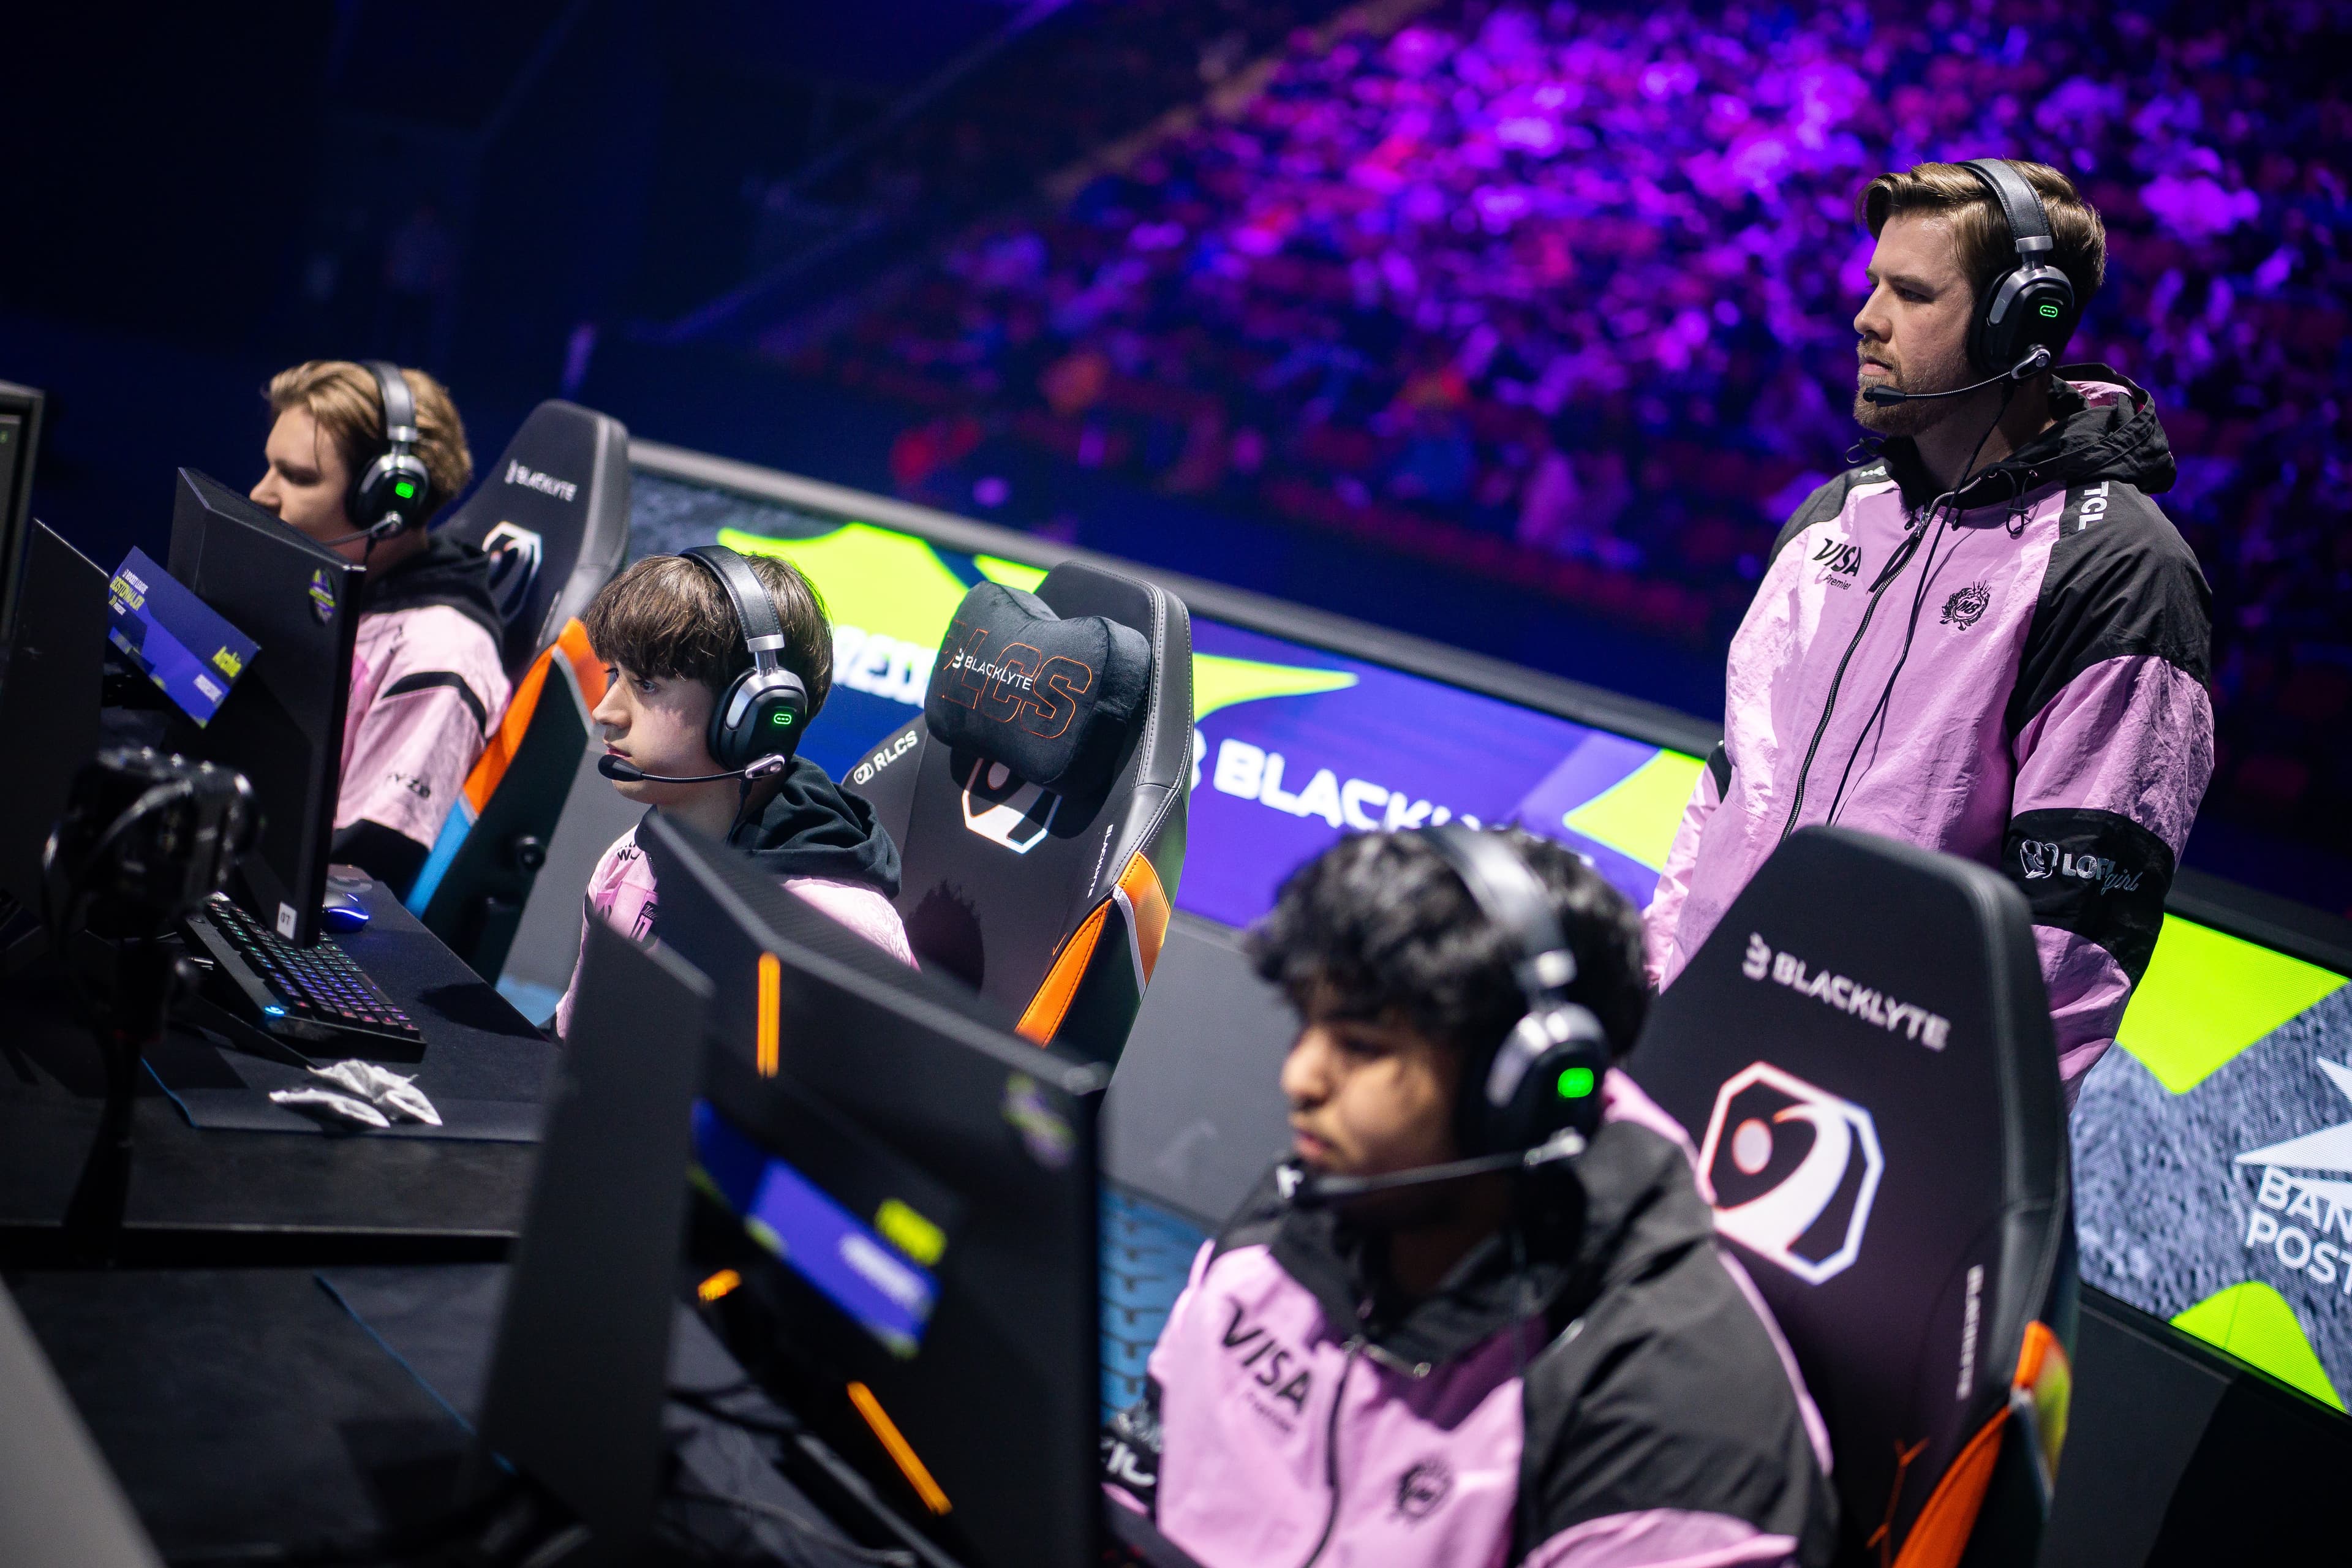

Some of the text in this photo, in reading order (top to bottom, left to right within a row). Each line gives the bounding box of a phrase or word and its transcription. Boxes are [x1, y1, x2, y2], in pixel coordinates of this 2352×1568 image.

[2077, 481, 2109, 531] TCL
[1812, 538, 1862, 577] VISA
[1823, 574, 1852, 590] Premier
[964, 655, 1034, 691] BLACKLYTE
[873, 729, 918, 771] RLCS
[2101, 869, 2143, 895] girl
[1772, 951, 1952, 1052] BLACKLYTE
[1222, 1294, 1311, 1415] VISA
